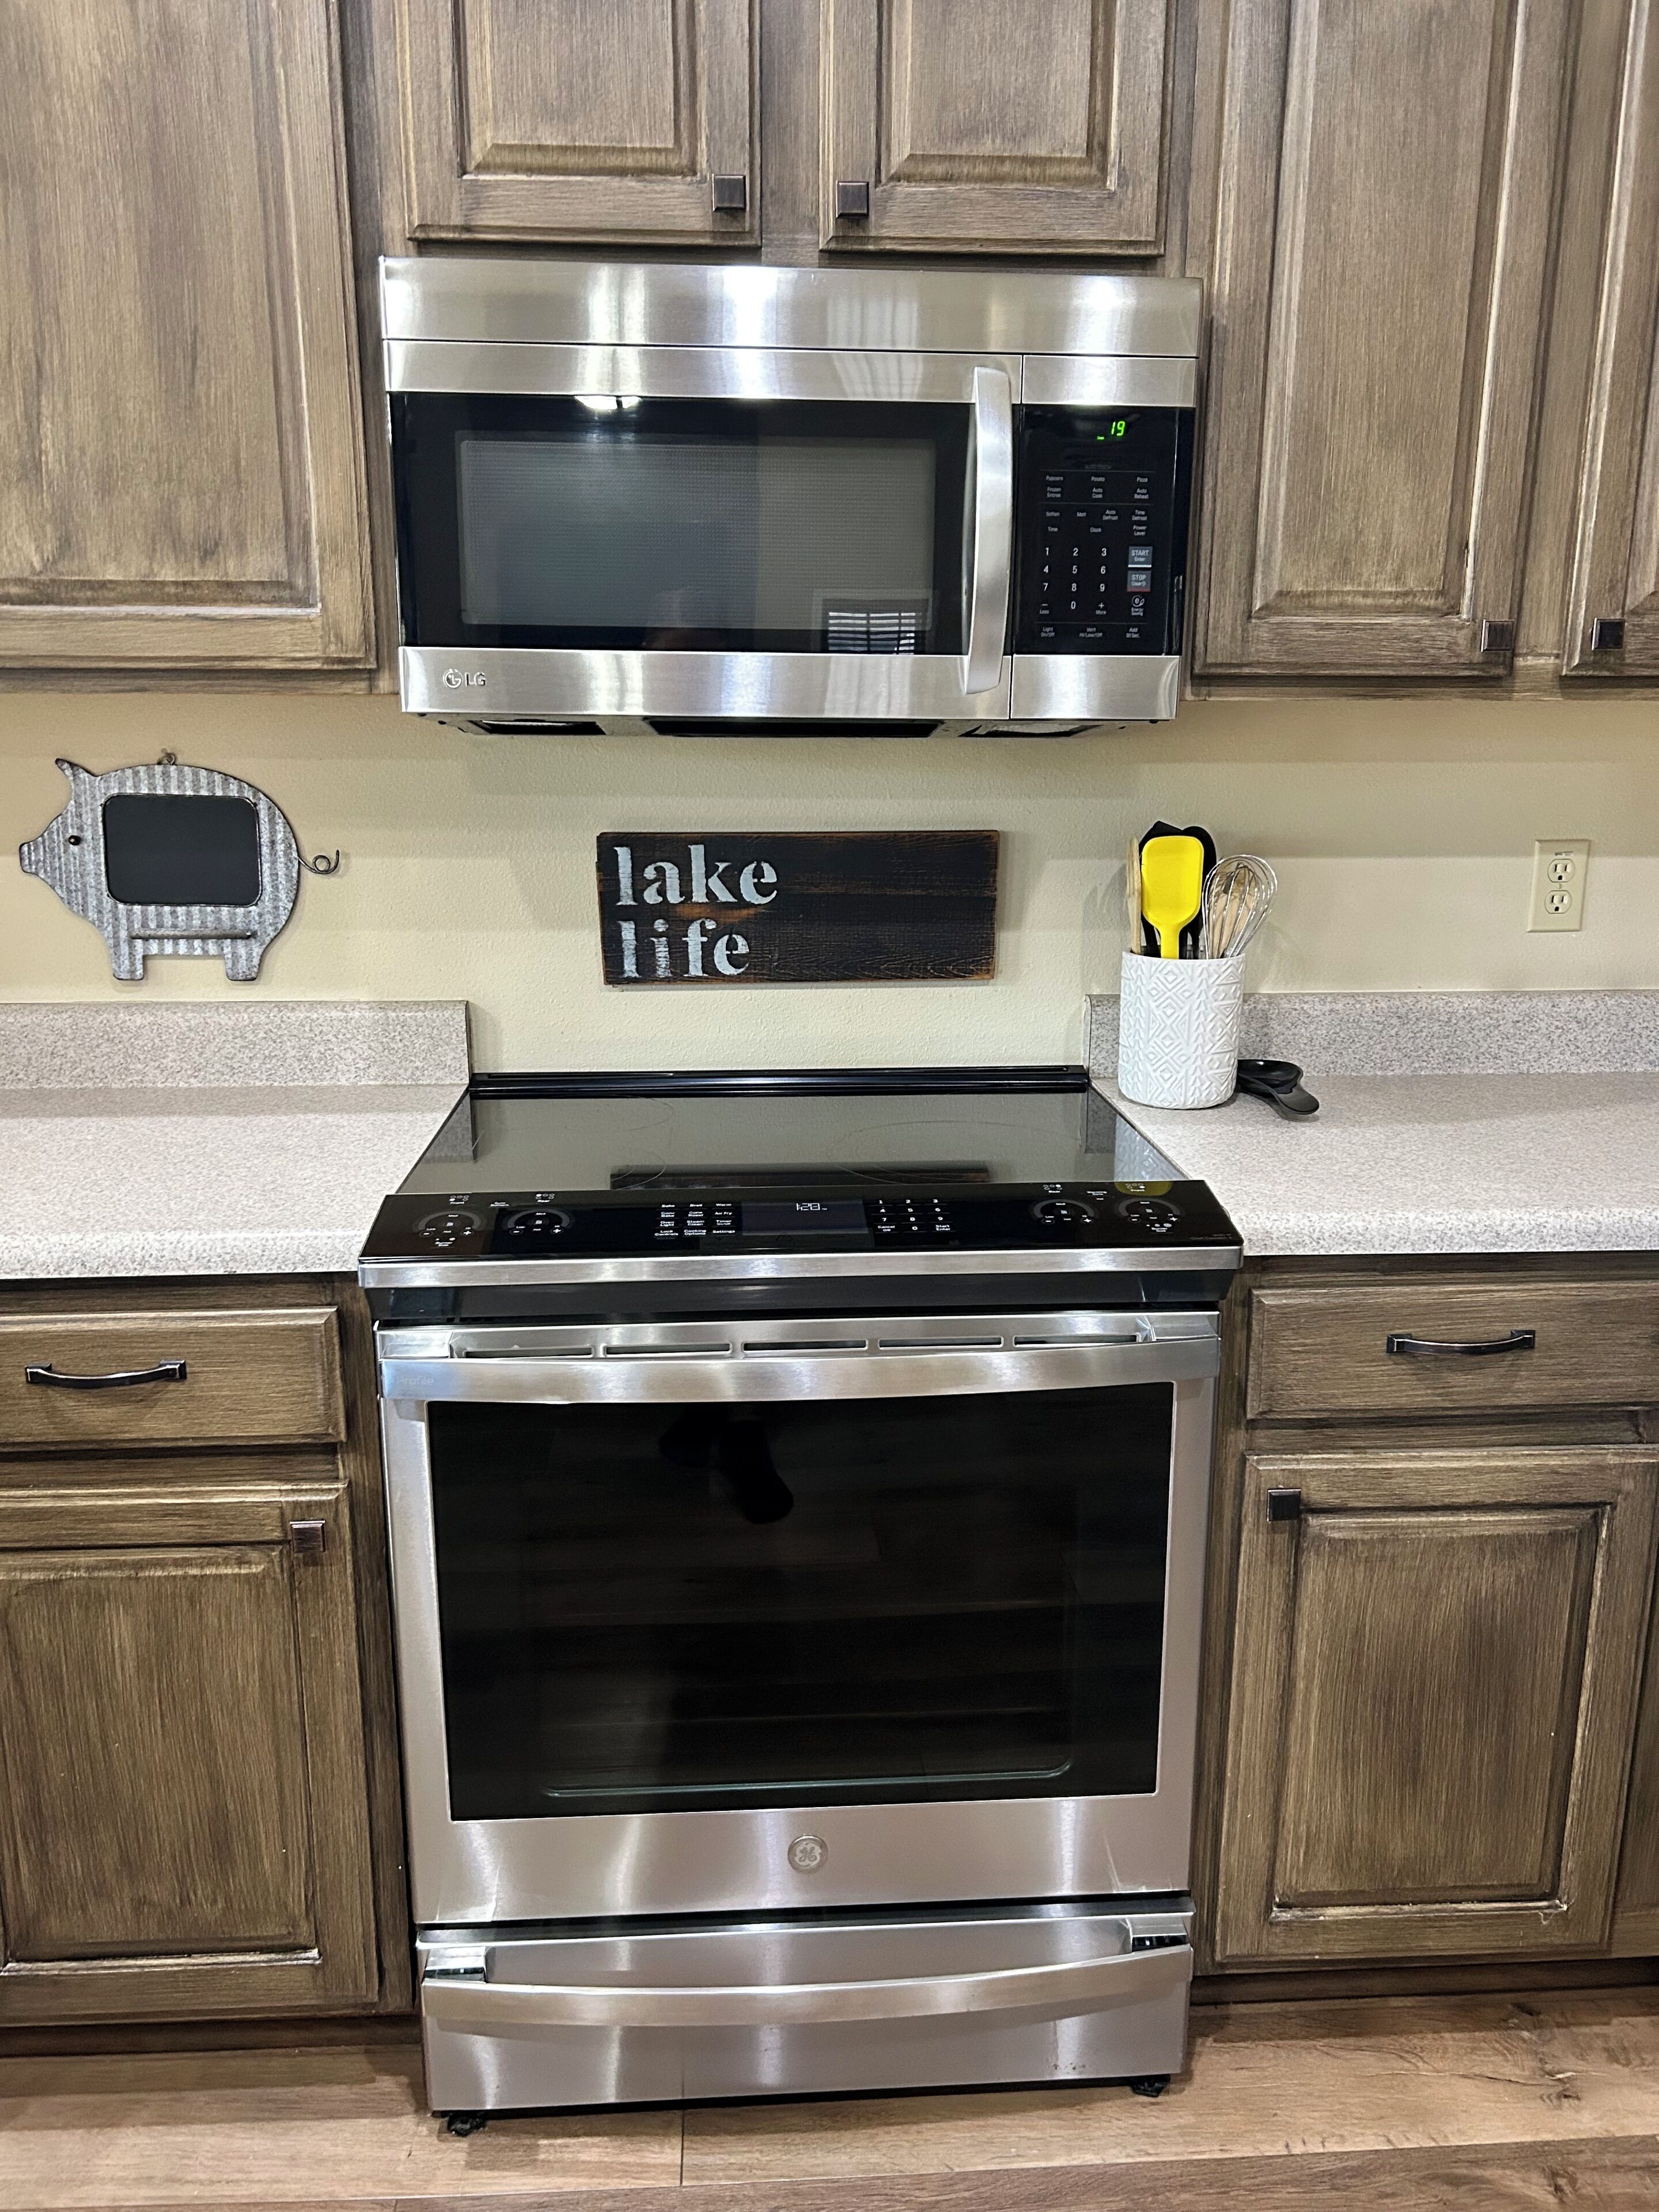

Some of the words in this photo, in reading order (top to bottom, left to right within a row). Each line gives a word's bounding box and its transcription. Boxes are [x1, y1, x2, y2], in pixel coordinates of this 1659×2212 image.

[1111, 421, 1125, 436] 19
[1046, 547, 1049, 556] 1
[1073, 548, 1078, 556] 2
[1101, 548, 1107, 556] 3
[1043, 565, 1049, 574] 4
[1072, 566, 1077, 574] 5
[1100, 566, 1106, 574] 6
[1043, 583, 1048, 591] 7
[1071, 583, 1077, 591] 8
[1100, 584, 1105, 592] 9
[1071, 601, 1076, 609] 0
[613, 844, 778, 906] lake
[618, 918, 749, 978] life
